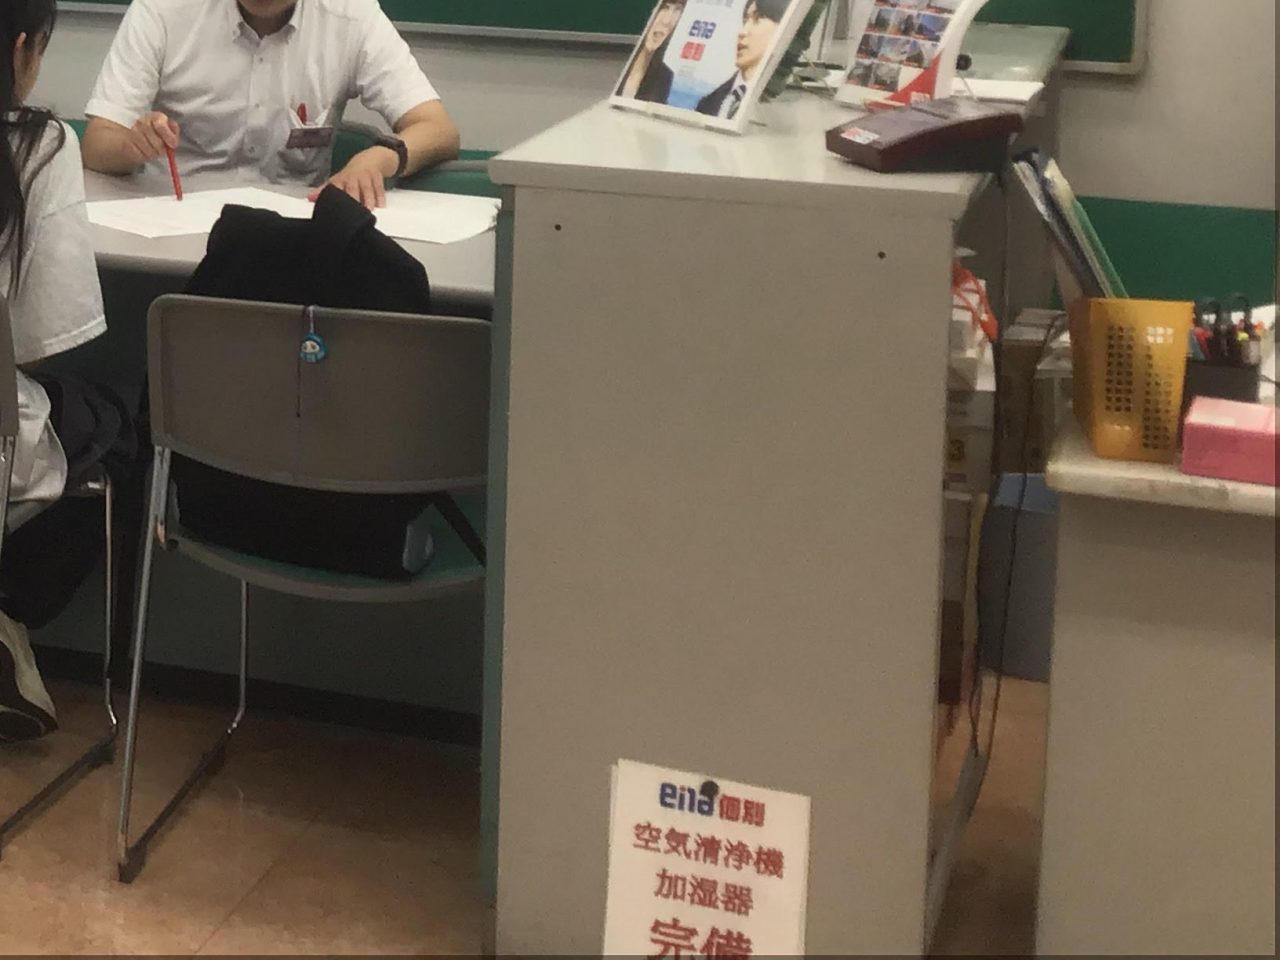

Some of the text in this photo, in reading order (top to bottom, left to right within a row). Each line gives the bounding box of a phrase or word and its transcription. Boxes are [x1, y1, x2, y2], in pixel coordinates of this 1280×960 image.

[632, 820, 785, 880] 空気清浄機
[653, 867, 754, 917] 加湿器
